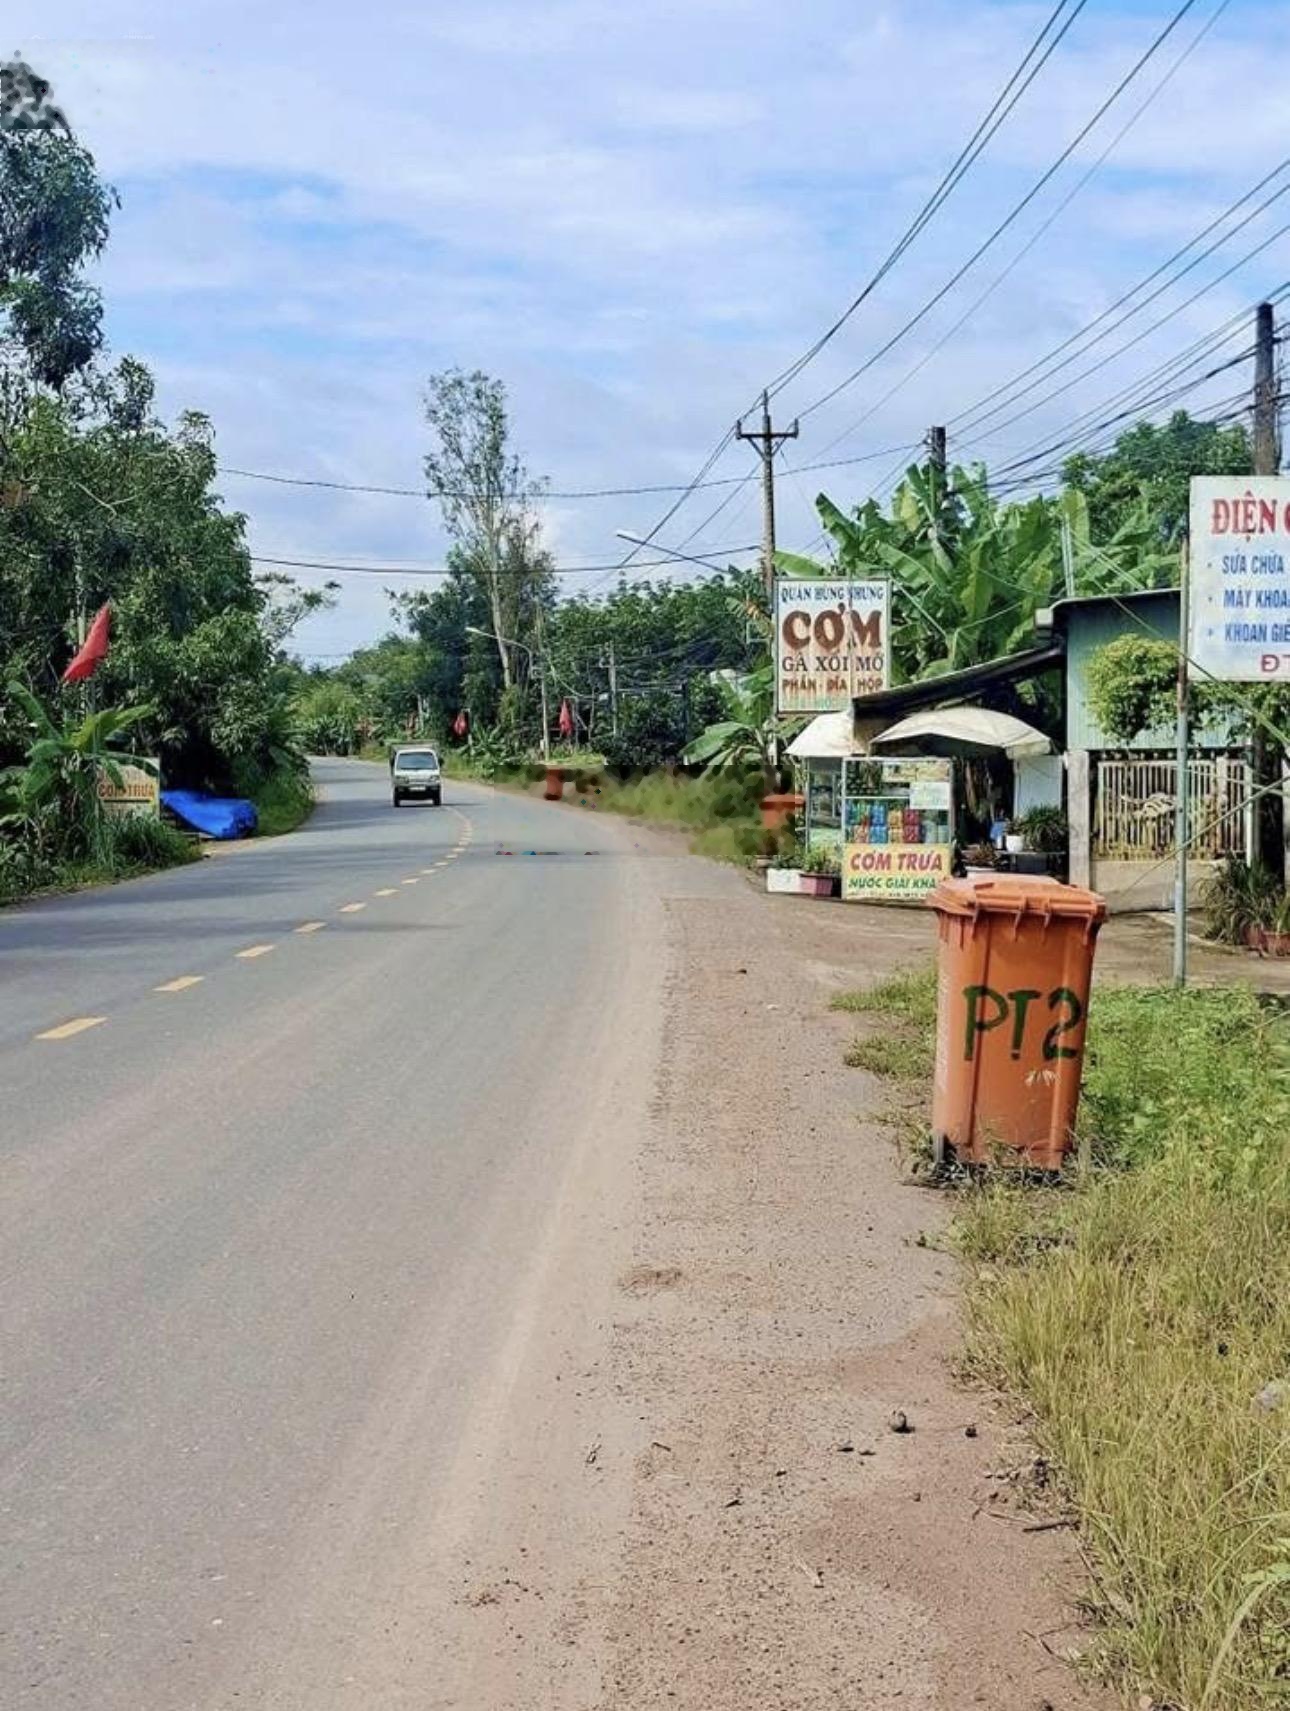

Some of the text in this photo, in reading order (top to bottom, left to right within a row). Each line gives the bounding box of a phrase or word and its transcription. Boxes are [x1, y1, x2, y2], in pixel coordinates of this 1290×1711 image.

[1211, 490, 1277, 542] ĐIỆN
[1255, 590, 1290, 608] KHOA
[782, 602, 881, 650] CƠM
[1225, 623, 1267, 642] KHOAN
[850, 850, 942, 871] CƠM TRƯA
[963, 984, 1081, 1061] PT2
